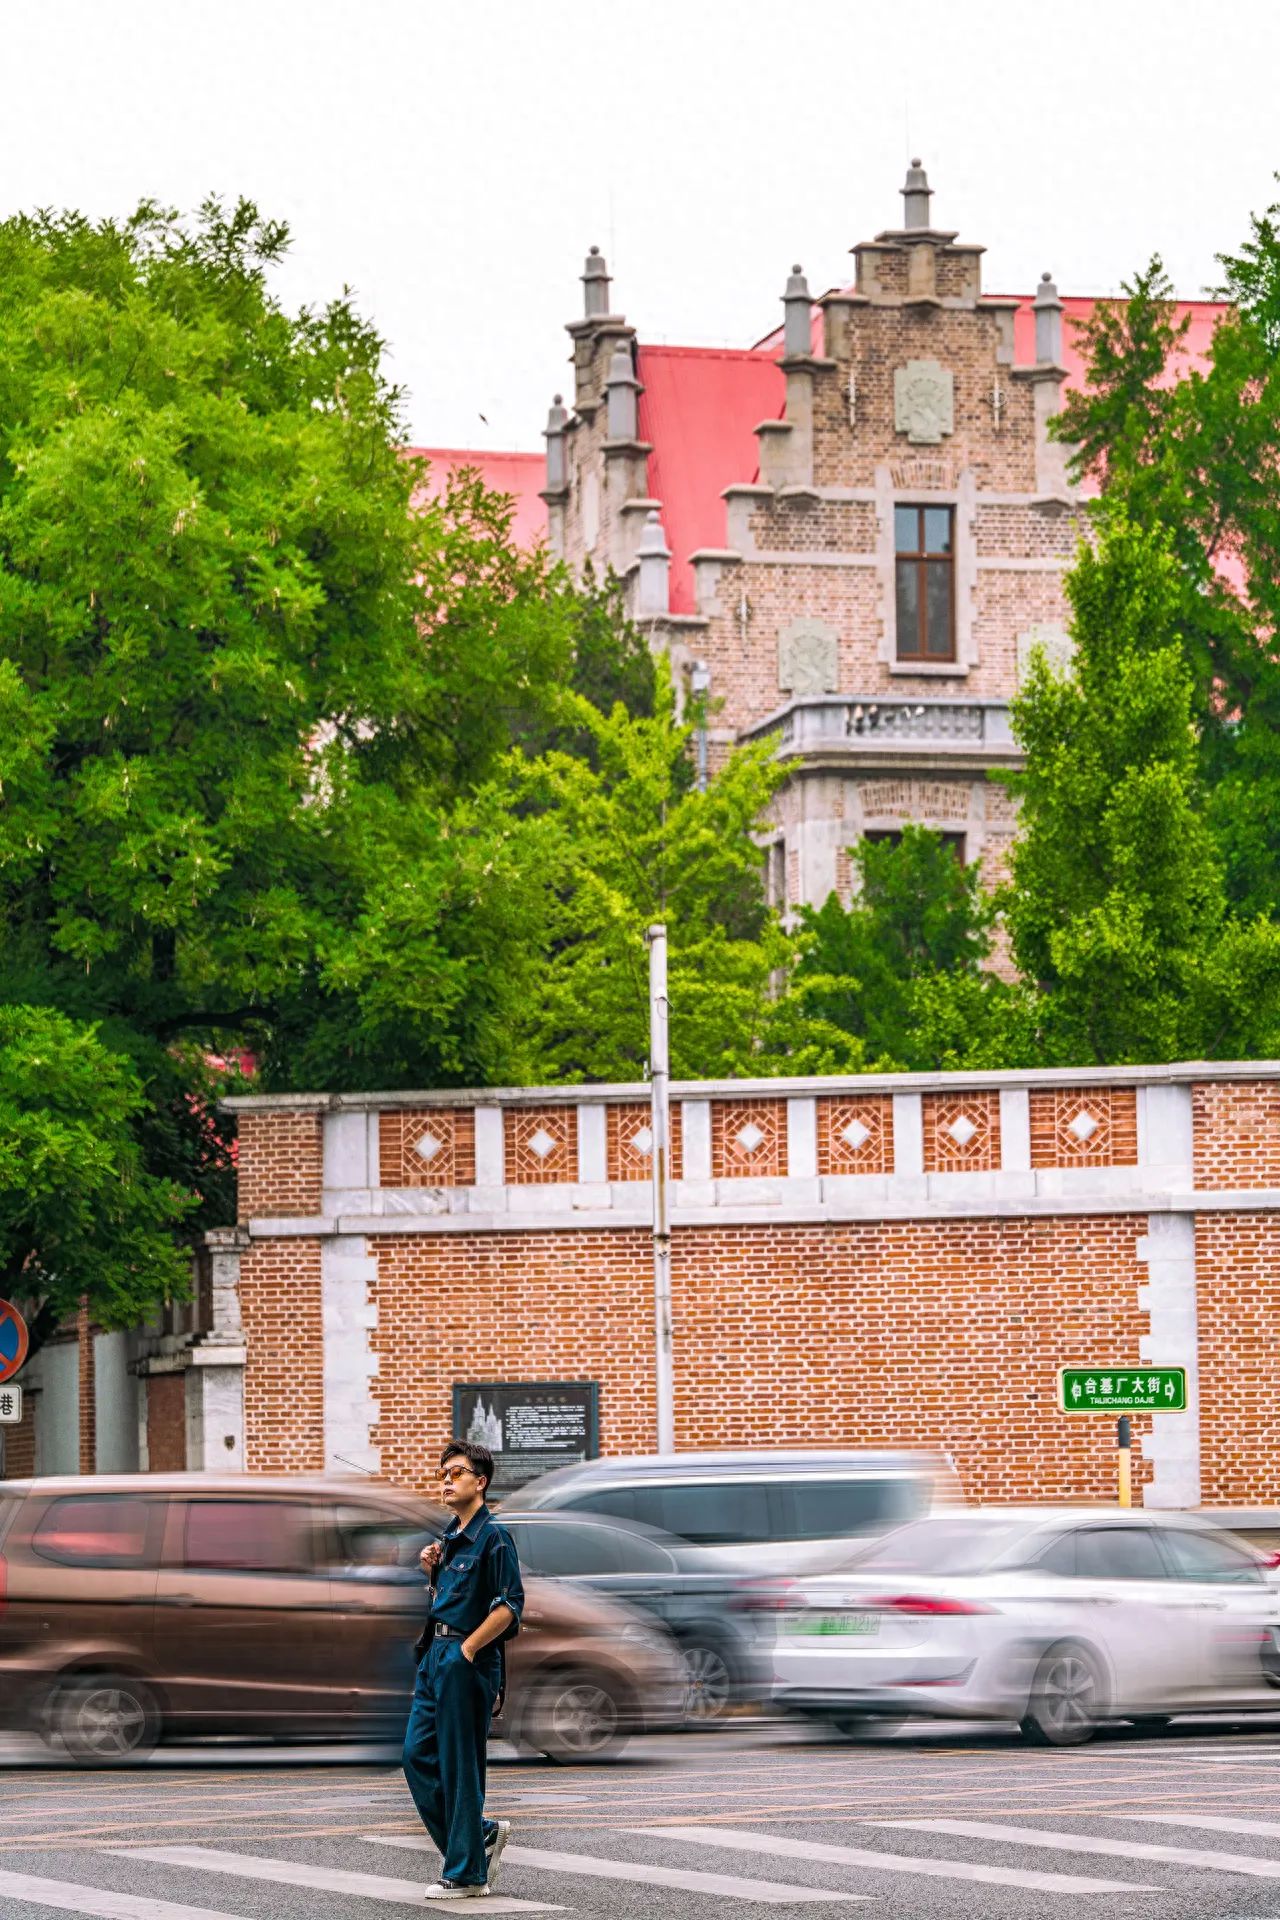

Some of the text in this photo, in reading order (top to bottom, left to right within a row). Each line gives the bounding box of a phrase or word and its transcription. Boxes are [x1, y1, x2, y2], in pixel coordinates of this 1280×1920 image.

[1084, 1376, 1161, 1394] 台基厂大街
[1134, 1396, 1155, 1404] DAJIE
